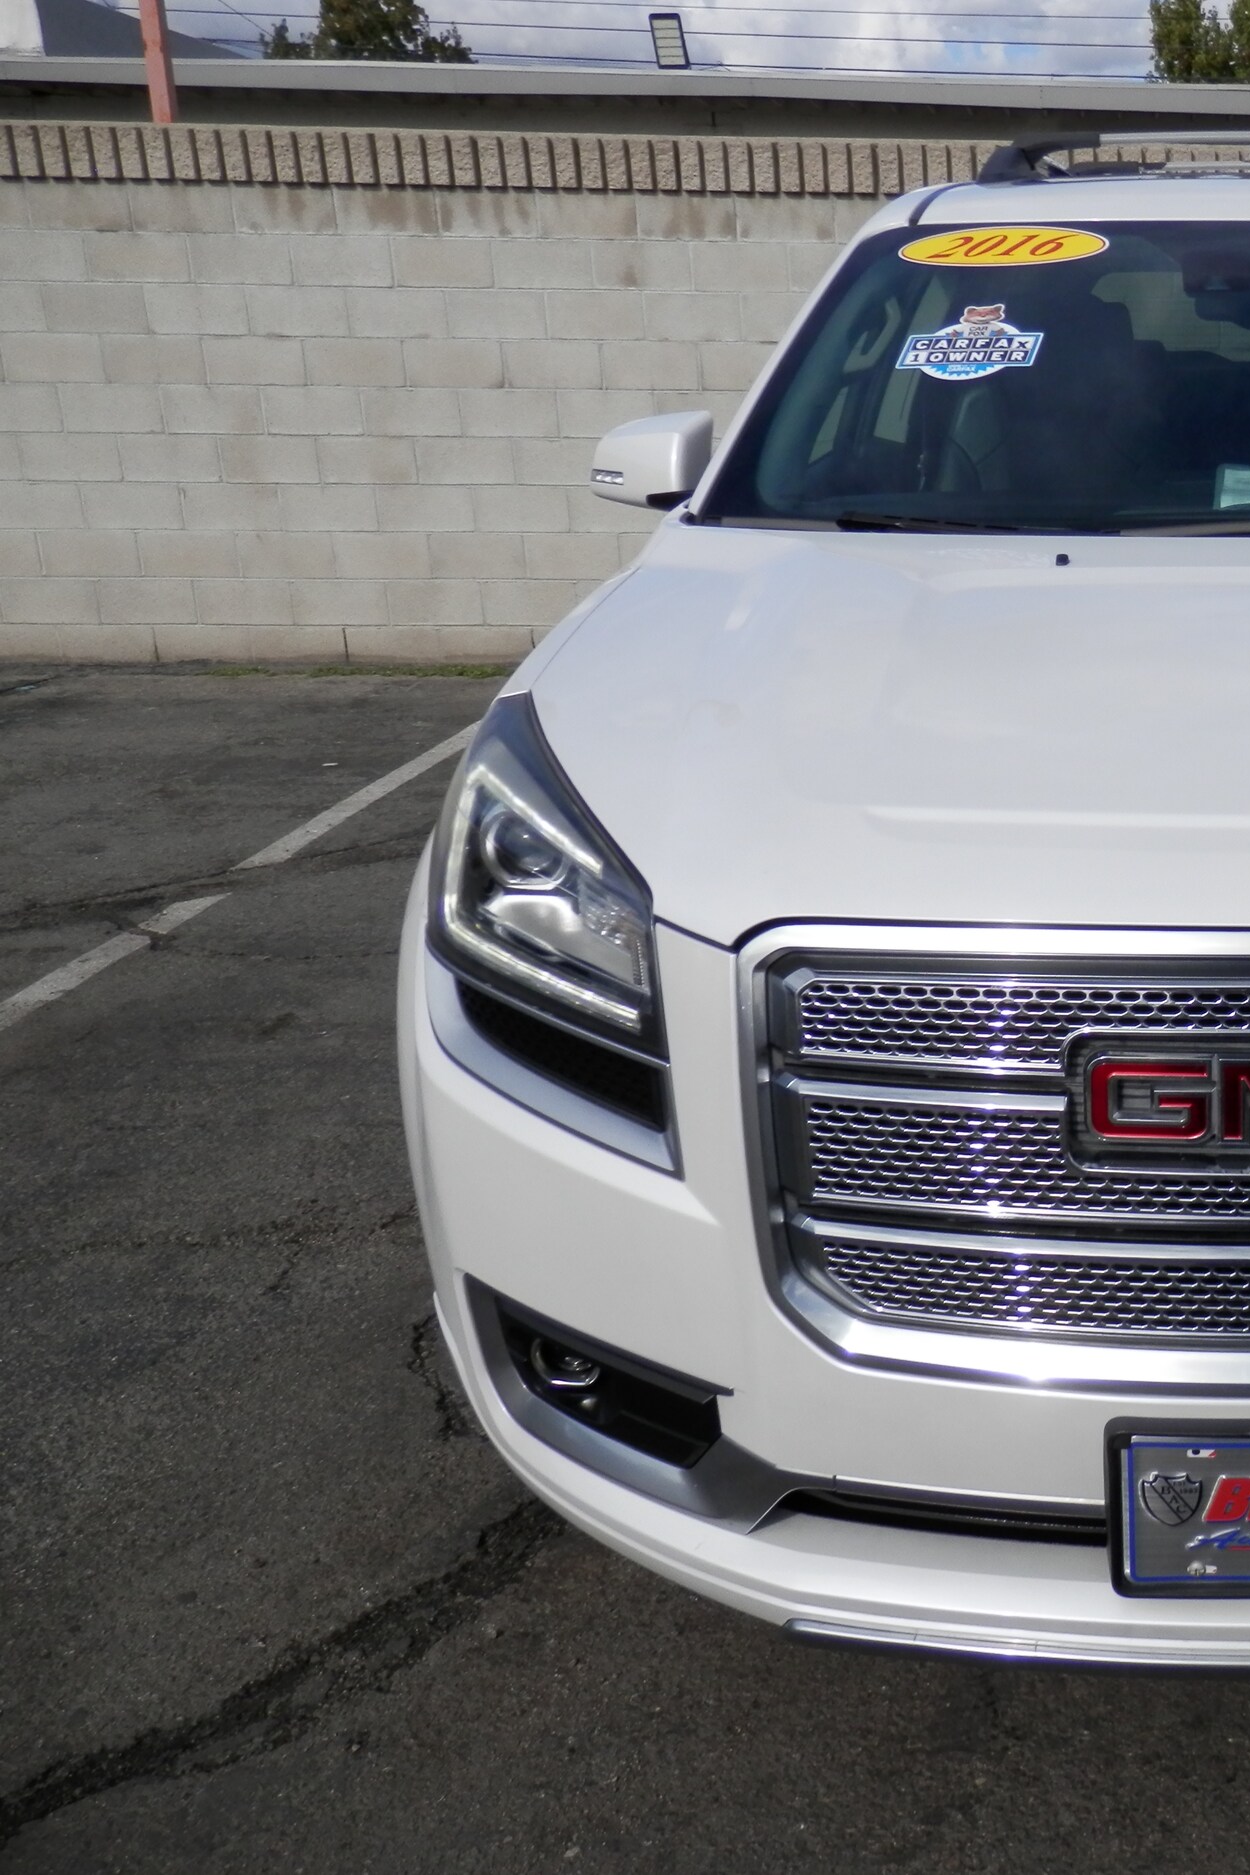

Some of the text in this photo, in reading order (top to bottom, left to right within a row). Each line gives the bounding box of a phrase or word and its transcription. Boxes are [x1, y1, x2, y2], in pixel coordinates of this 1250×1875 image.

[925, 233, 1079, 259] 2016
[915, 338, 1030, 350] CARFAX
[929, 352, 1025, 363] OWNER
